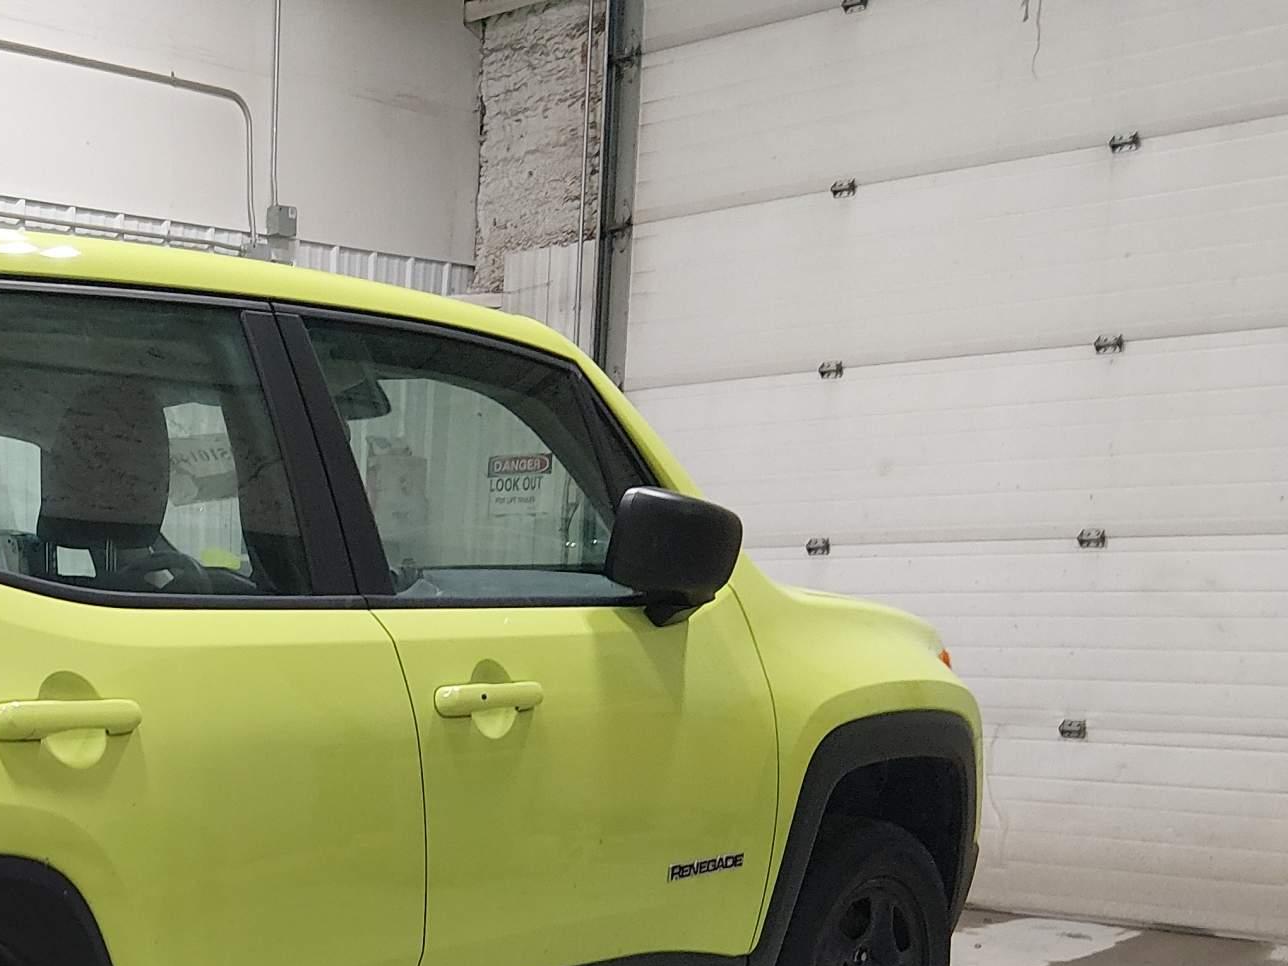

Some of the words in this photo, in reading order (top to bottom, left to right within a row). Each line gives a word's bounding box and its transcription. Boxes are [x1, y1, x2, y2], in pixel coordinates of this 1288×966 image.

[493, 459, 541, 472] DANGER
[490, 477, 520, 492] LOOK
[522, 475, 544, 491] OUT
[668, 853, 744, 882] RENEGADE
